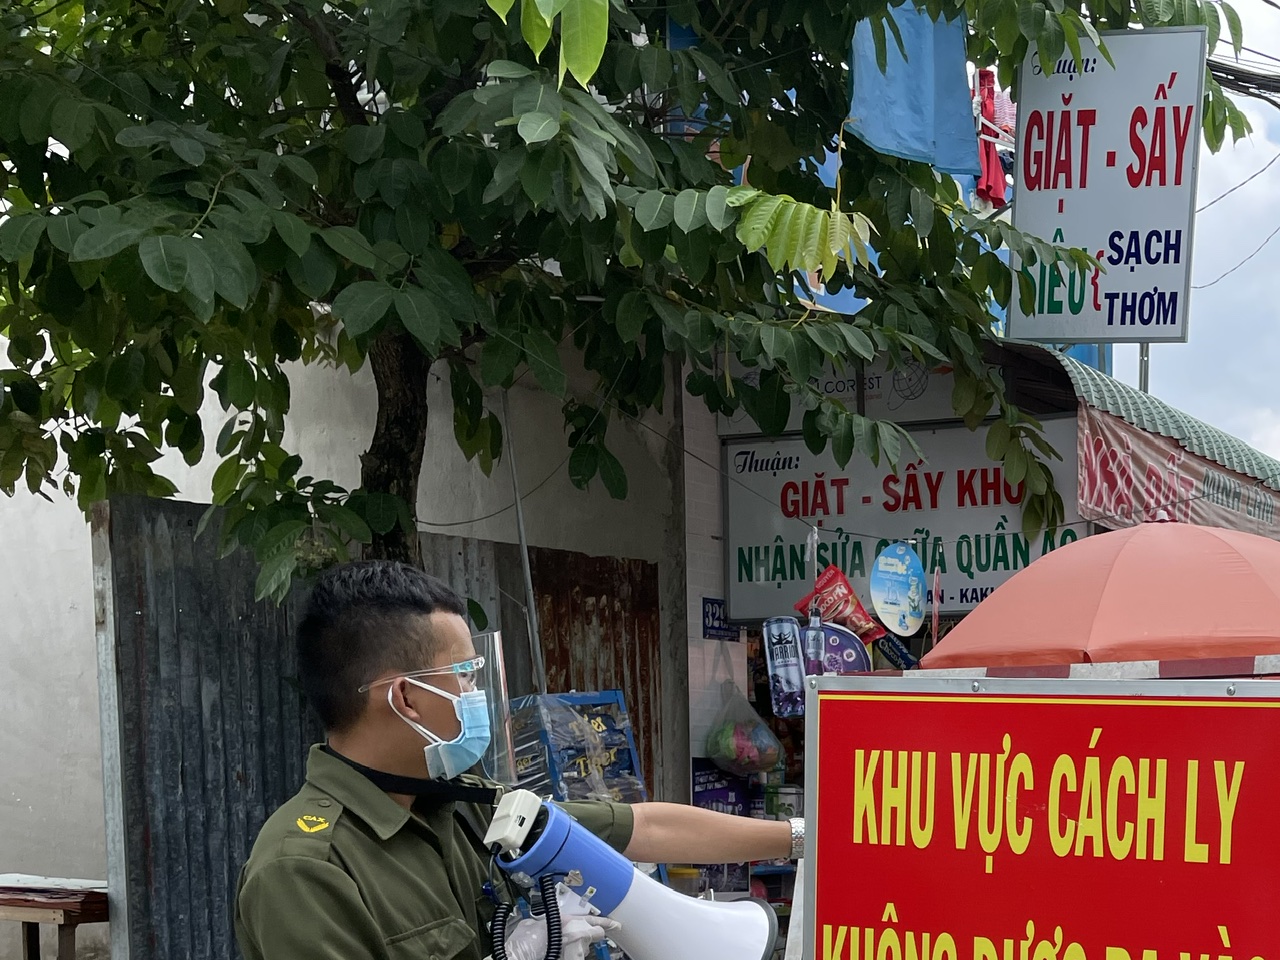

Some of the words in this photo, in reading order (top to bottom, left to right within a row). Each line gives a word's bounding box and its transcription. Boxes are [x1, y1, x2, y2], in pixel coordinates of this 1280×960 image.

[1023, 93, 1096, 213] GIẶT
[1126, 72, 1193, 188] SẤY
[1107, 230, 1182, 272] SẠCH
[1104, 286, 1178, 326] THƠM
[781, 472, 849, 527] GIẶT
[882, 458, 944, 512] SẤY
[738, 535, 806, 588] NHẬN
[956, 515, 1030, 579] QUẦN
[853, 750, 936, 849] KHU
[951, 733, 1034, 874] VỰC
[1048, 728, 1168, 861] CÁCH
[1184, 760, 1245, 864] LY
